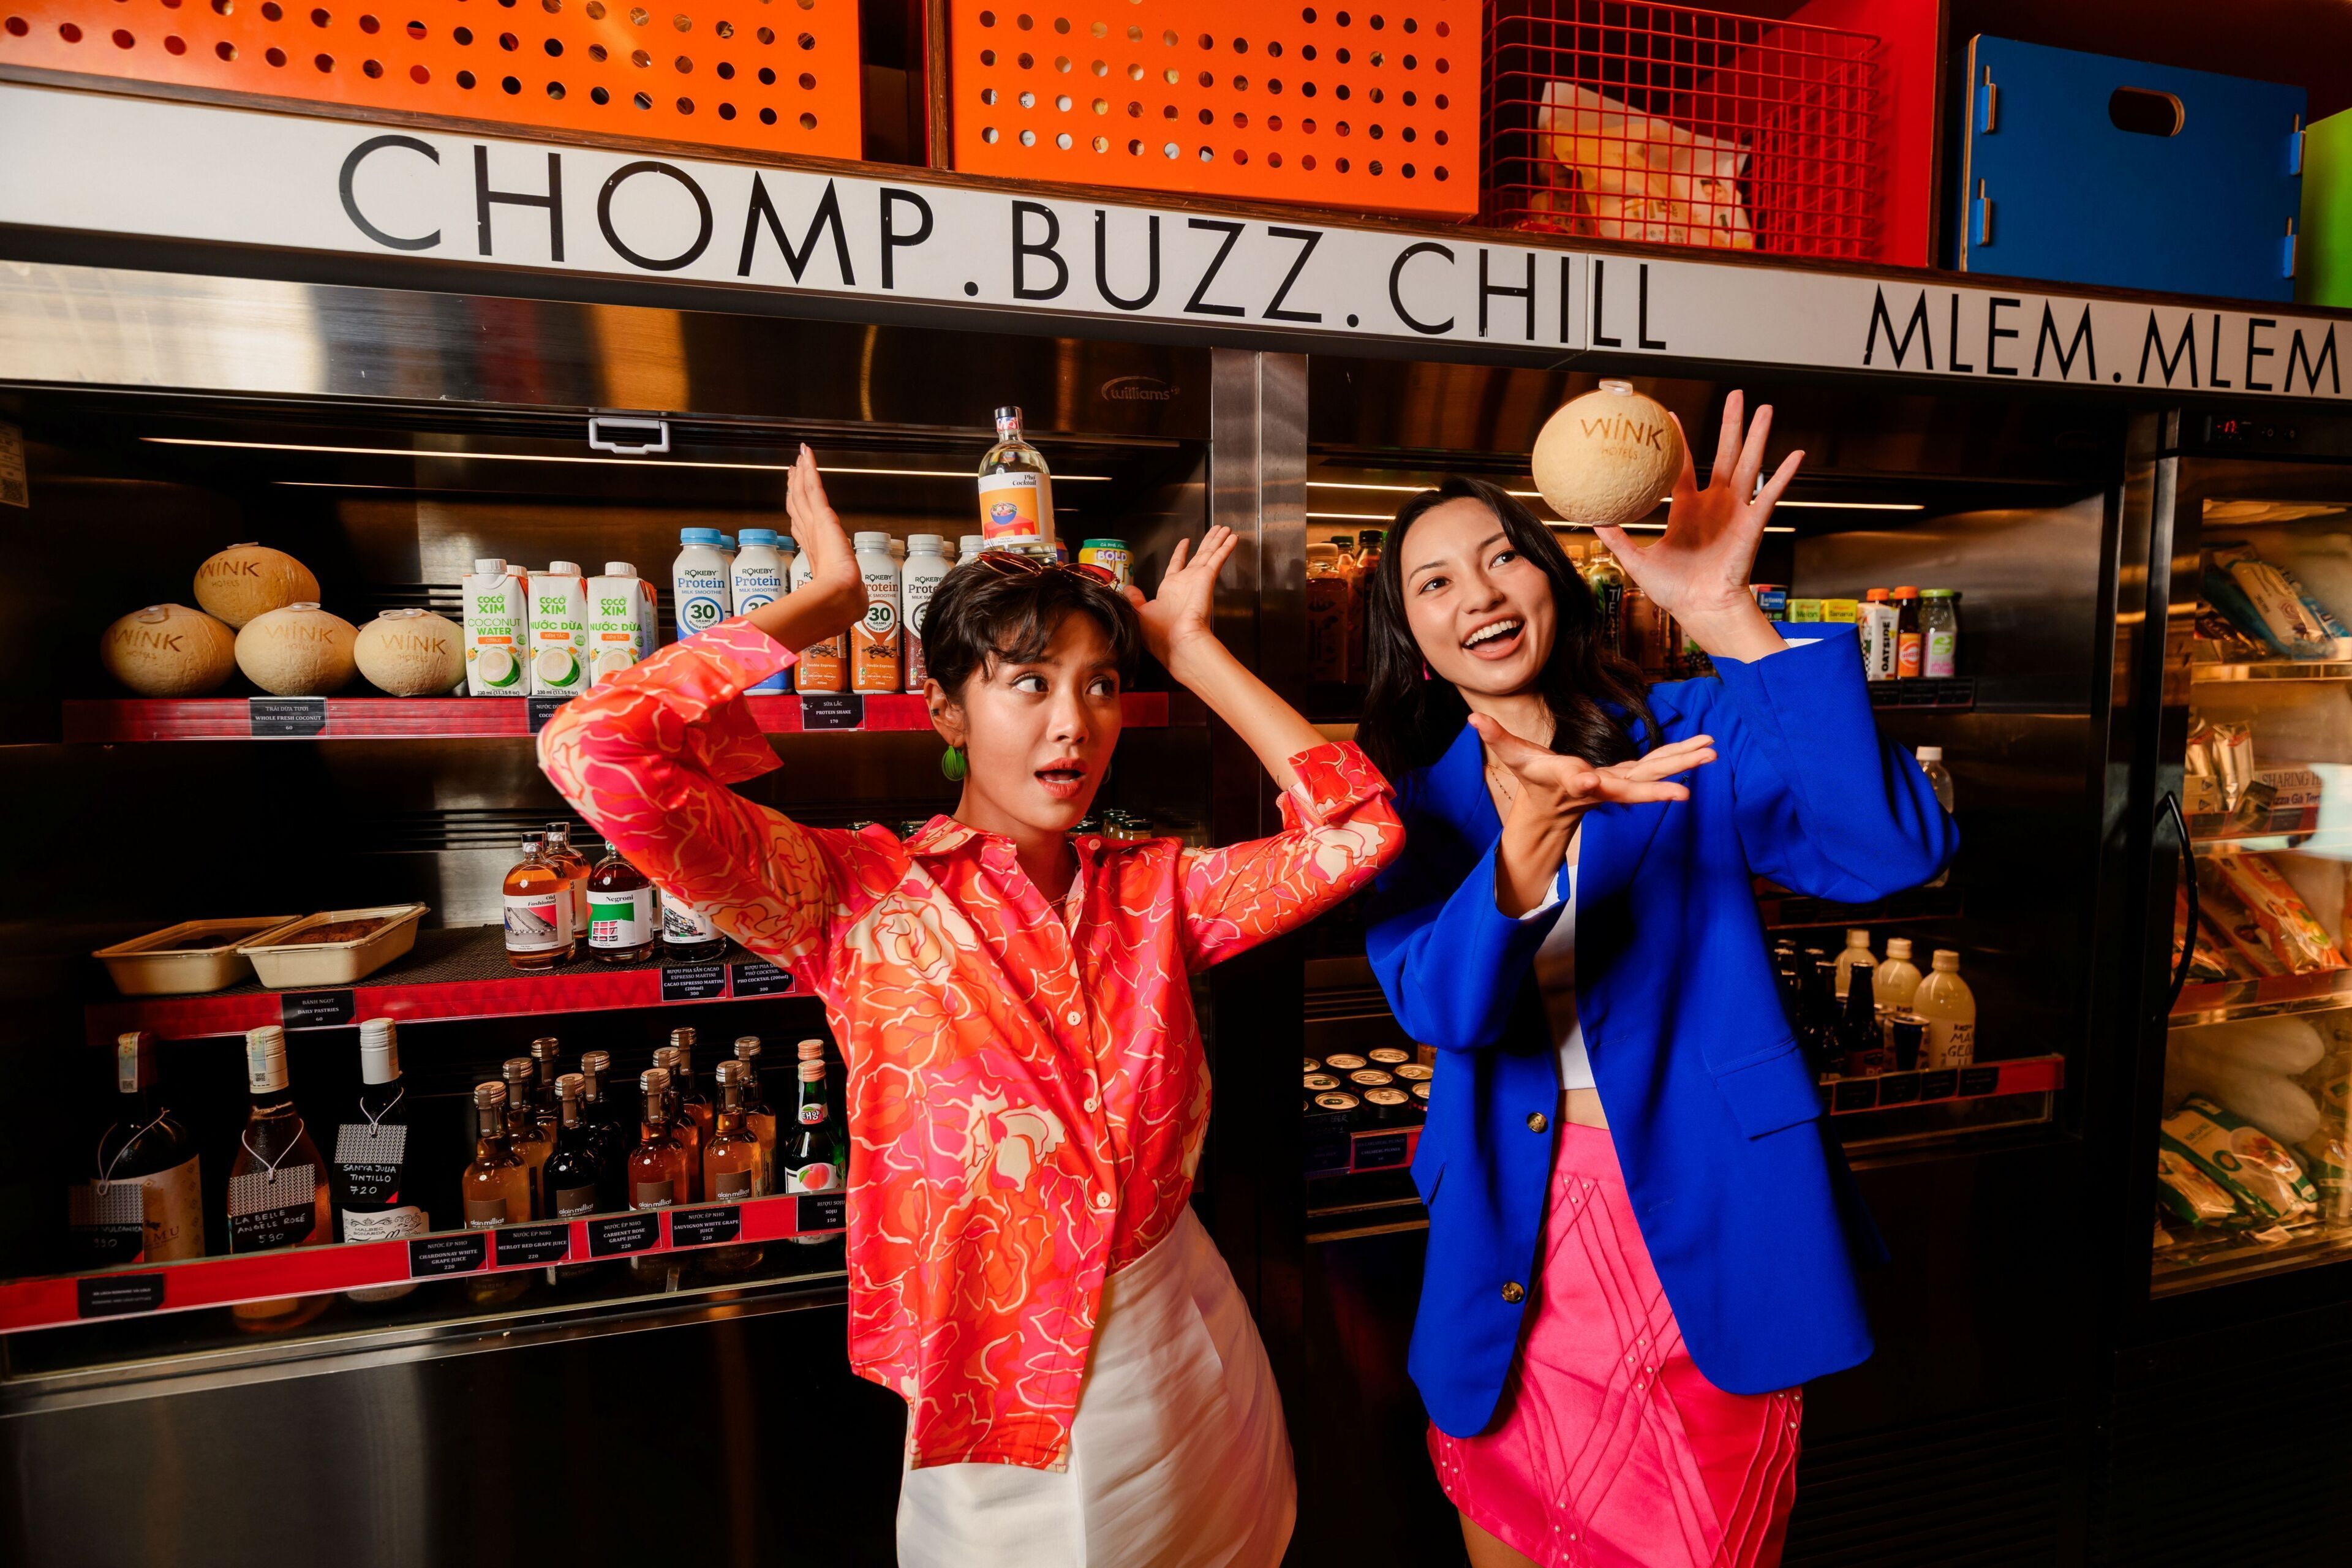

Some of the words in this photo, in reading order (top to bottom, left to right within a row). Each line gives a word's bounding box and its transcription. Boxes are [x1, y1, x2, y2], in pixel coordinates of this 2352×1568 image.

[1110, 386, 1170, 400] williams
[1601, 447, 1638, 460] HOTELS
[1096, 550, 1127, 562] BOLD
[677, 578, 725, 588] Protein
[735, 576, 782, 586] Protein
[478, 604, 505, 614] XIM
[540, 604, 566, 615] XIM
[601, 606, 627, 616] XIM
[691, 604, 715, 619] 30
[869, 608, 891, 621] 30
[468, 619, 521, 627] COCONUT
[530, 620, 557, 630] NƯỚC
[561, 620, 583, 630] DỪA
[590, 621, 618, 631] NƯỚC
[621, 621, 642, 631] DỪA
[1882, 621, 1891, 671] OATSIDE
[126, 650, 157, 660] HOTELS
[398, 654, 428, 663] HOTELS
[2262, 772, 2309, 788] SHARING
[605, 894, 633, 903] Negroni
[801, 1110, 820, 1121] 태양
[375, 1165, 397, 1174] JULIA
[350, 1174, 391, 1182] TINTILLO
[350, 1186, 377, 1194] 720
[575, 1203, 593, 1212] milliat
[255, 1210, 285, 1221] BELLE
[284, 1213, 306, 1224] ROSÉ
[258, 1234, 284, 1243] 590
